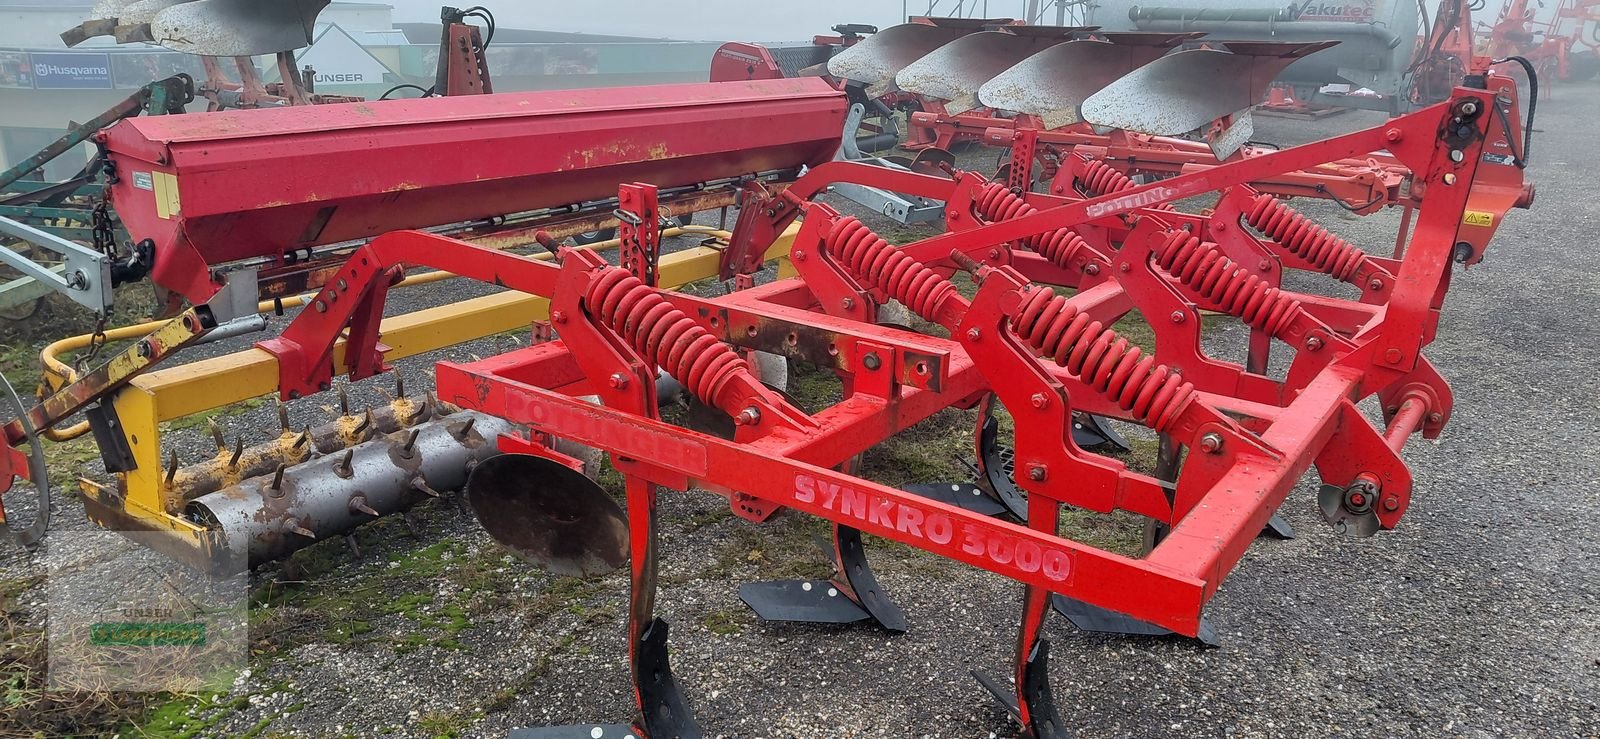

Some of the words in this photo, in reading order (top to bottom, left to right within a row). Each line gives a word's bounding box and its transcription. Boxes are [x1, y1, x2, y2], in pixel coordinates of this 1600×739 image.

[48, 65, 107, 76] Husqvarna
[315, 74, 363, 82] UNSER
[794, 474, 954, 545] SYNKRO
[961, 523, 1071, 582] 3000
